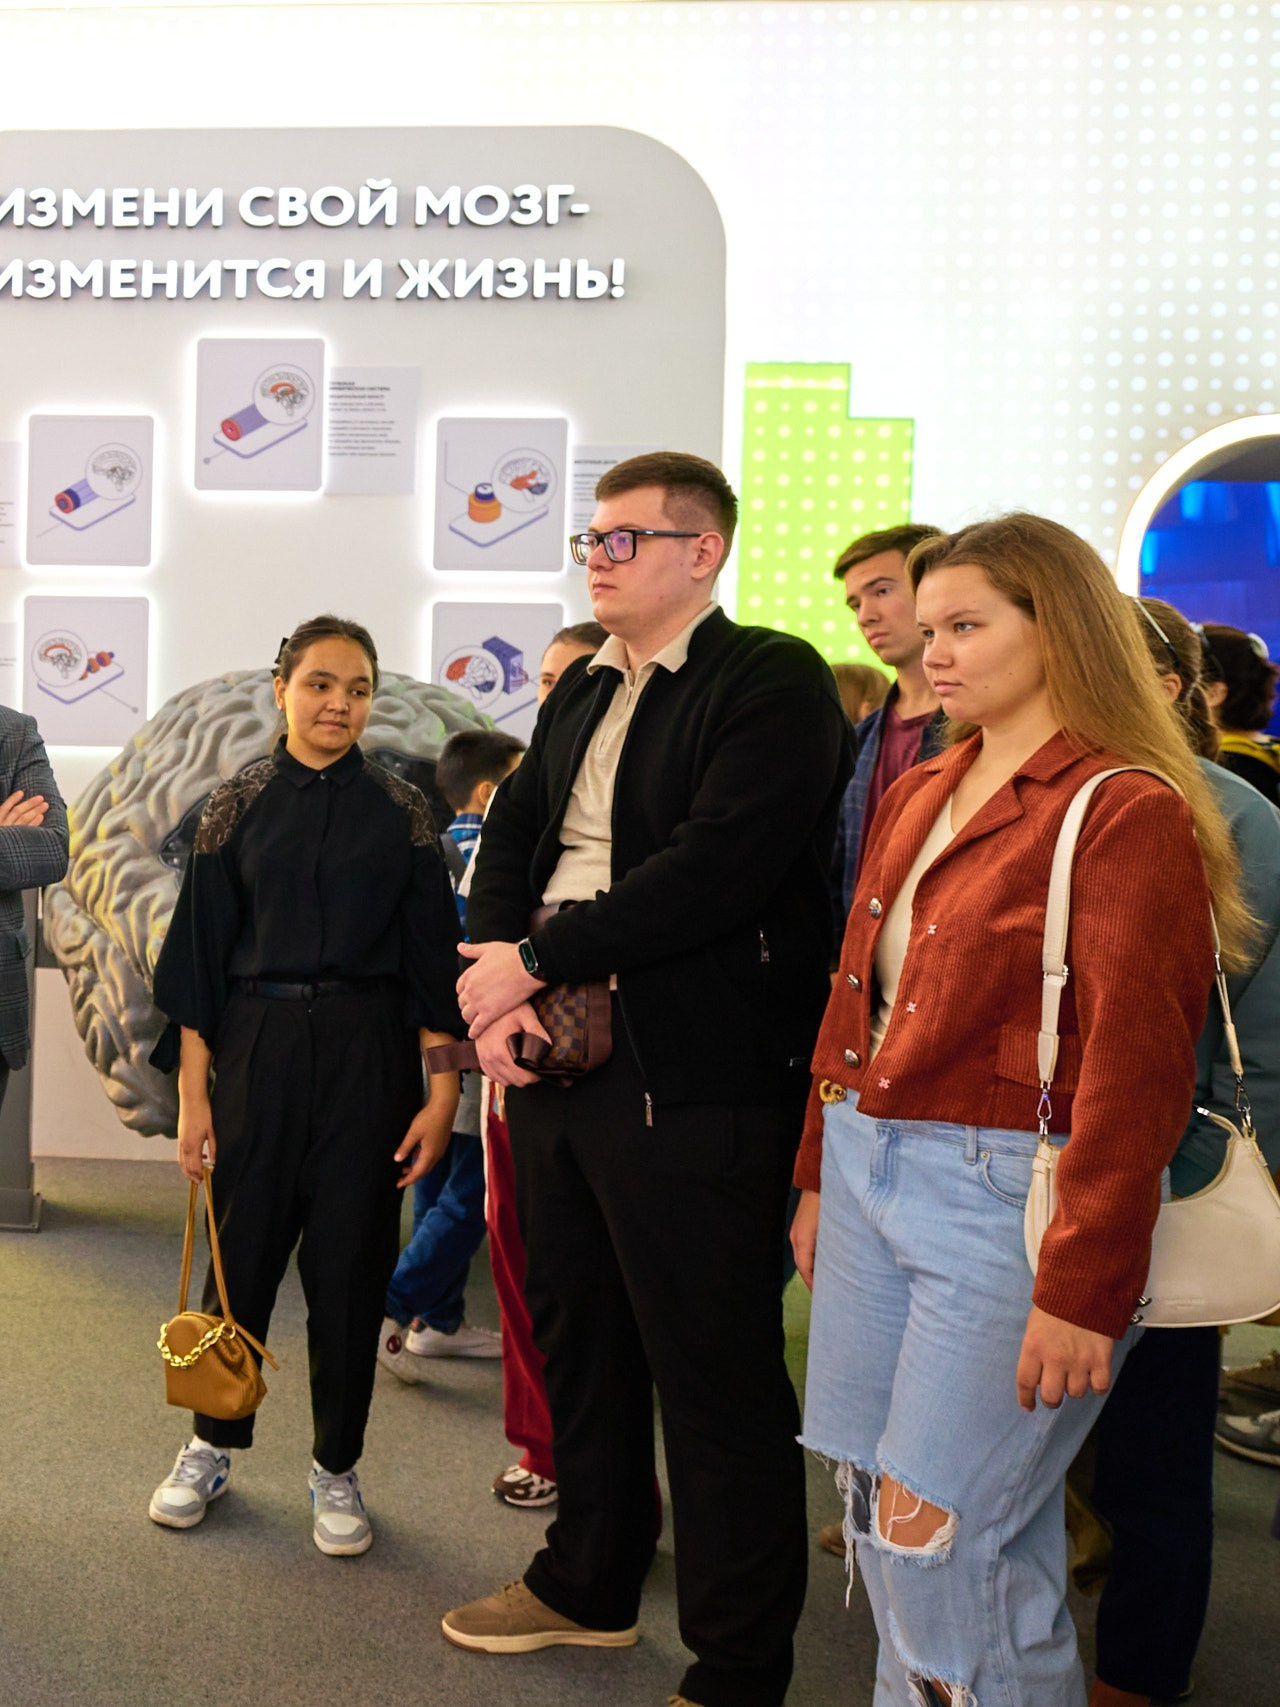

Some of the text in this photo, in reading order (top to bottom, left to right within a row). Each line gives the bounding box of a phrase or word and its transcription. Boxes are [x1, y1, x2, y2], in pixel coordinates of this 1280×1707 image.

[239, 178, 398, 227] СВОЙ
[415, 184, 591, 226] МОЗГ-
[343, 259, 383, 299] И
[396, 257, 627, 300] ЖИЗНЬ!
